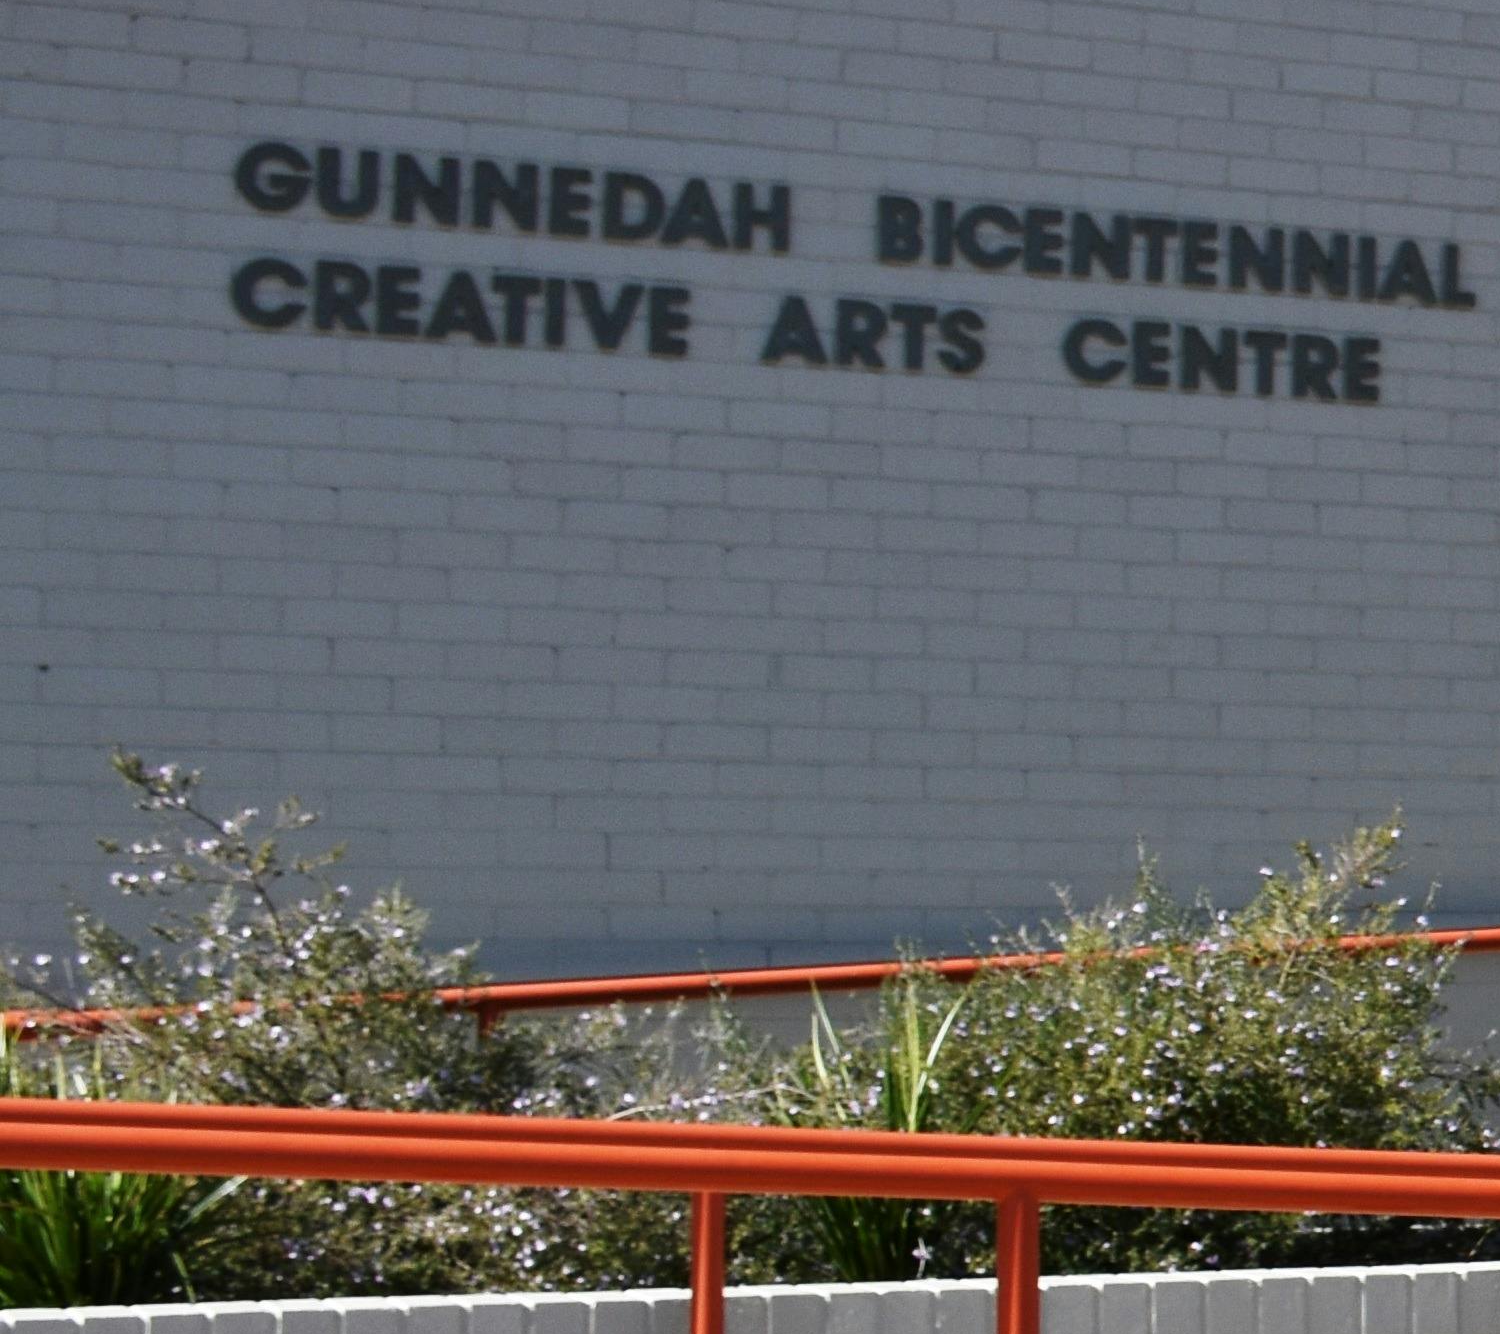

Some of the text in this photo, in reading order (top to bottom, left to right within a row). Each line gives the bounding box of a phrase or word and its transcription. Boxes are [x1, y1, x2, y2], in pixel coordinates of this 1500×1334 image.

[233, 140, 1476, 308] GUNNEDAH BICENTENNIAL
[231, 257, 1382, 403] CREATIVE ARTS CENTRE
